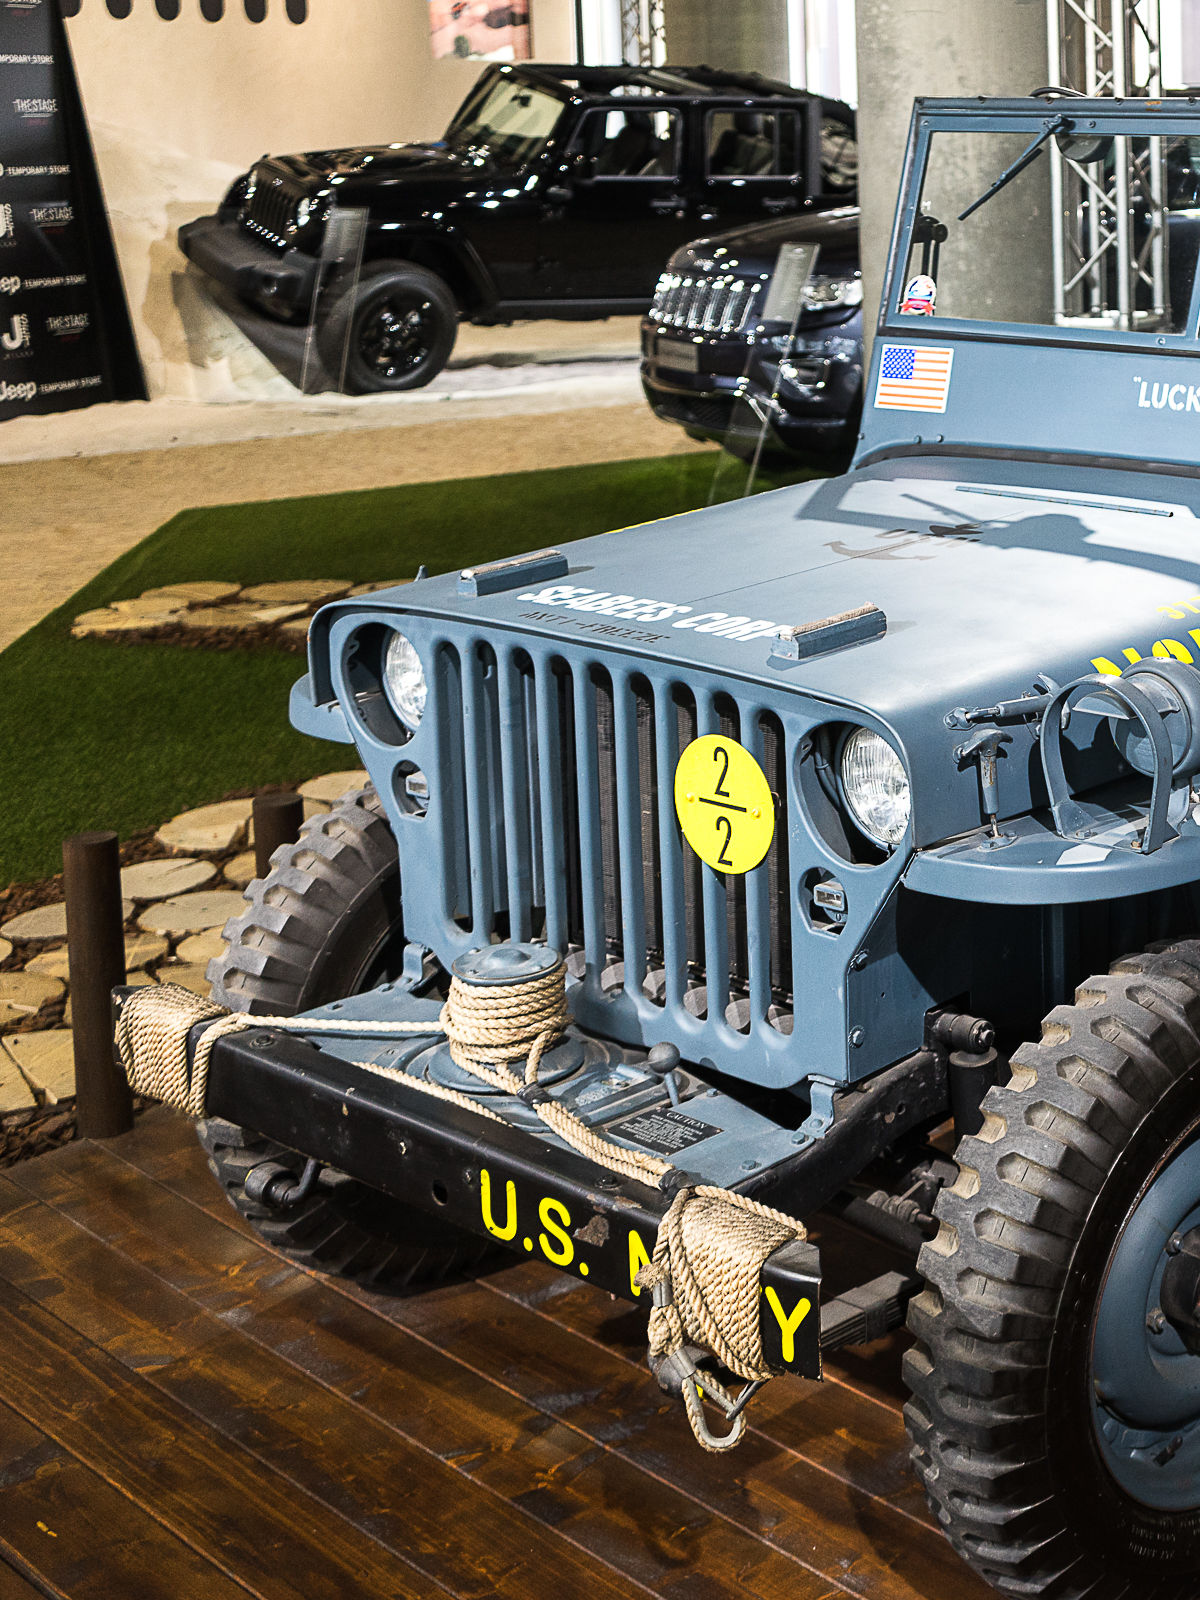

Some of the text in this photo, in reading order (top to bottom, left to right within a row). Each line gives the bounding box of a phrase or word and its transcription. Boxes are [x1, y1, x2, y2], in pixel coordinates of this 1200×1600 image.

[517, 585, 793, 642] SEABEES CORP
[713, 746, 730, 797] 2
[715, 816, 733, 867] 2
[480, 1169, 589, 1276] U.S.
